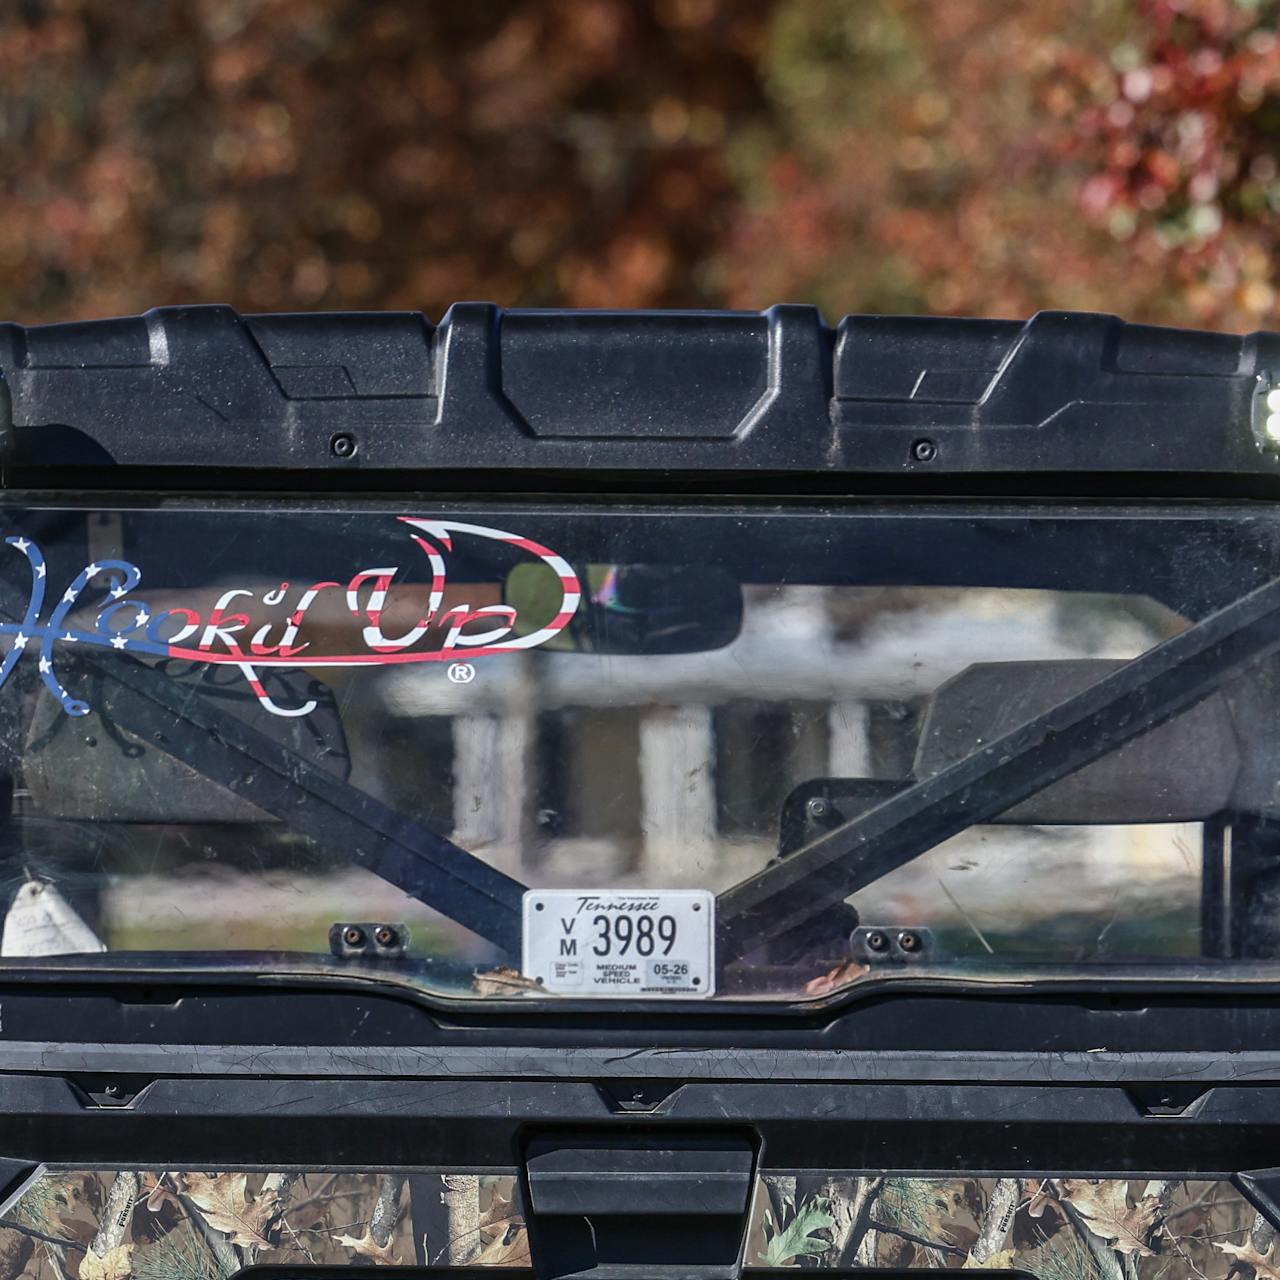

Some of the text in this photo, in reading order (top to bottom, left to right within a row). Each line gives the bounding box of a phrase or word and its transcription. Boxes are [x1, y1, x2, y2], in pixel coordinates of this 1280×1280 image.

[346, 533, 518, 654] Up
[577, 897, 660, 914] Tennessee
[593, 915, 677, 956] 3989
[653, 964, 688, 974] 05-26
